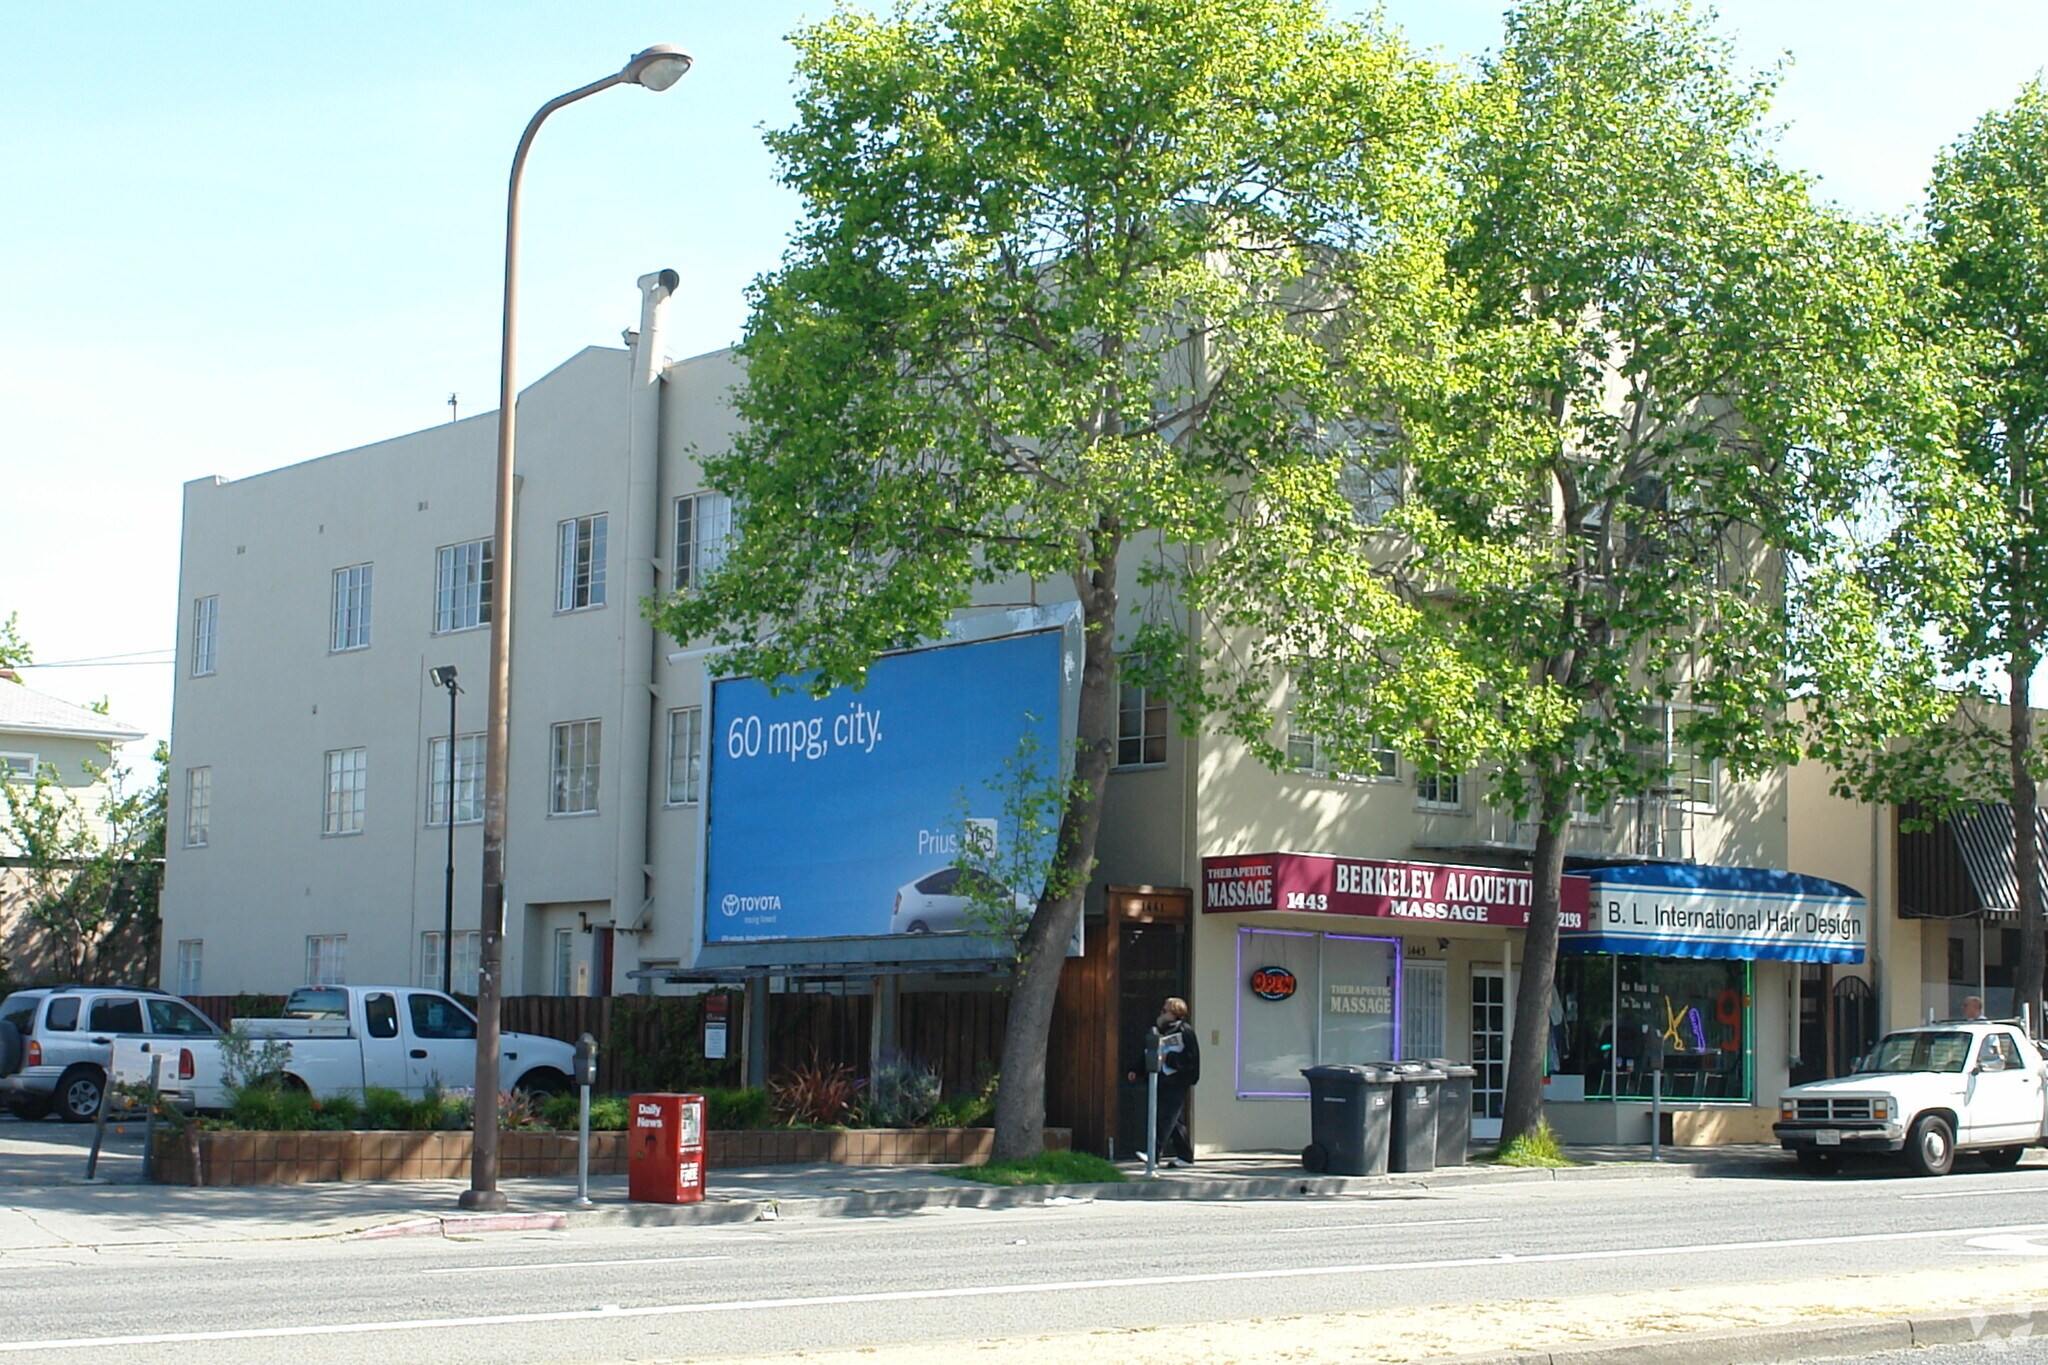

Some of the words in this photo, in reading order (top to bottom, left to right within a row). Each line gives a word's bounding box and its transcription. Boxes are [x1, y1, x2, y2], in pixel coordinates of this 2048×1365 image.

[728, 715, 762, 759] 60
[768, 717, 828, 762] mpg,
[834, 702, 882, 753] city.
[1207, 865, 1272, 879] THERAPEUTIC
[1336, 864, 1435, 899] BERKELEY
[1207, 879, 1272, 907] MASSAGE
[1286, 892, 1328, 910] 1443
[741, 896, 781, 911] TOYOTA
[1391, 900, 1488, 922] MASSAGE
[1608, 901, 1627, 924] B.
[1632, 904, 1649, 926] L.
[1655, 904, 1761, 931] International
[1767, 911, 1800, 932] Hair
[1806, 912, 1861, 940] Design
[1253, 971, 1294, 994] OPEN
[1330, 984, 1391, 996] THERAPEUTIC
[1330, 996, 1391, 1014] MASSAGE
[638, 1104, 662, 1117] Daily
[637, 1117, 663, 1128] News
